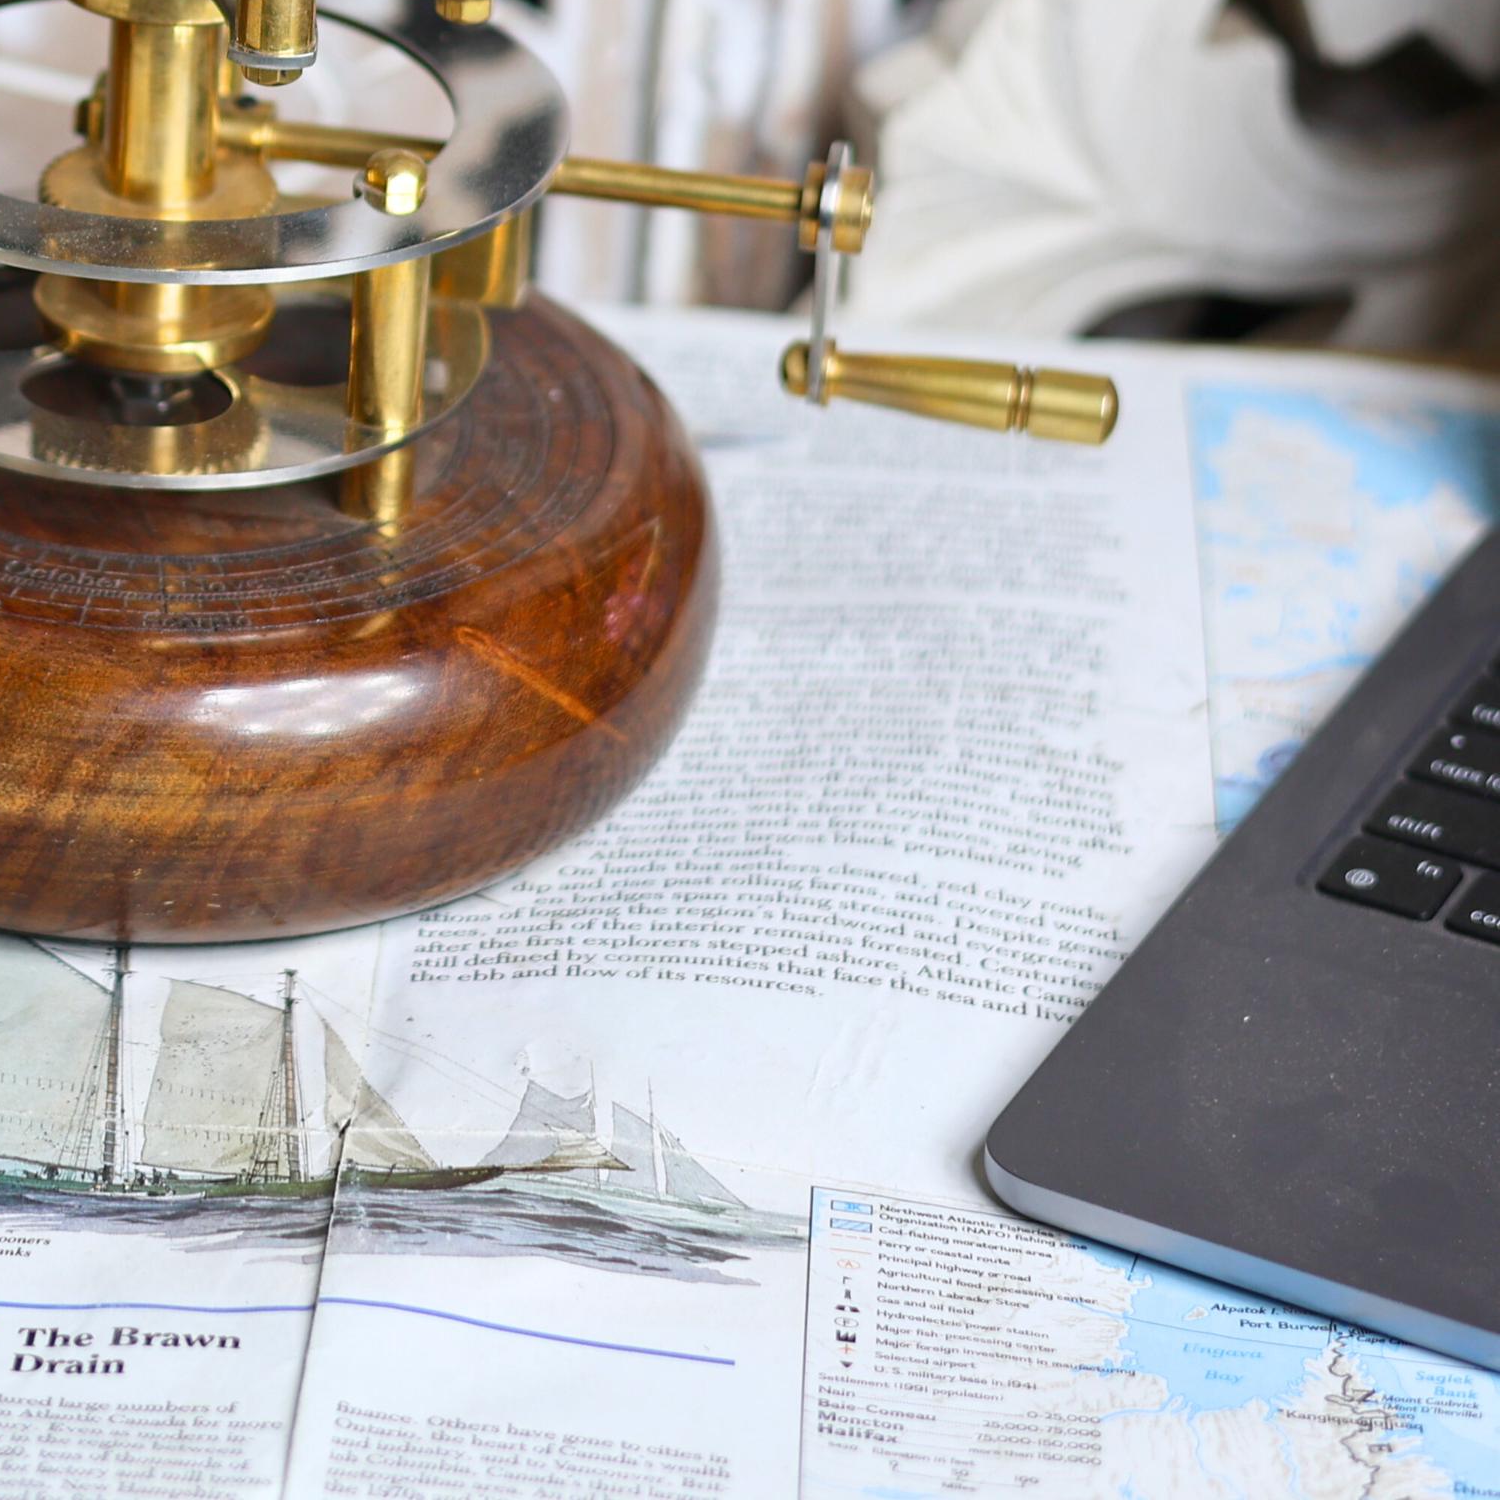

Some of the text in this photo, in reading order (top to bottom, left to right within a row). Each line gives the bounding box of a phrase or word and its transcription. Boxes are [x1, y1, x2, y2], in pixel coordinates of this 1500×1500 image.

[4, 559, 127, 590] October
[1388, 814, 1443, 840] shift
[1416, 860, 1443, 878] fn
[413, 941, 472, 953] after
[479, 937, 519, 951] the
[525, 935, 575, 947] first
[582, 934, 700, 950] explorers
[707, 939, 809, 958] stepped
[917, 964, 1015, 994] Atlantic
[410, 964, 824, 997] the ebb and flow of its resources.
[412, 955, 459, 969] still
[463, 949, 561, 968] defined
[567, 949, 597, 966] by
[604, 954, 770, 971] communities
[777, 960, 826, 978] that
[833, 967, 883, 986] face
[890, 970, 929, 996] the
[937, 990, 976, 1006] sea
[982, 1000, 1028, 1016] and
[879, 1212, 958, 1232] Organization
[1015, 1234, 1055, 1247] fishing
[1060, 1242, 1088, 1250] zone
[880, 1204, 1055, 1238] Northwest Atlantic Fisheries
[878, 1239, 911, 1252] Ferry
[930, 1249, 973, 1260] coastal
[977, 1256, 1010, 1266] route
[879, 1226, 1053, 1258] Cod-fishing moratorium area
[878, 1253, 932, 1267] Principal
[935, 1261, 984, 1278] highway
[1004, 1274, 1031, 1282] road
[877, 1267, 1097, 1305] Agricultural food-processing center
[877, 1281, 1030, 1309] Northern Labrador Store
[877, 1295, 974, 1316] Gas and oil field
[1211, 1303, 1266, 1316] Akpatok
[1239, 1319, 1273, 1329] Port
[17, 1327, 241, 1349] The Brawn
[1183, 1343, 1262, 1359] Ungava
[11, 1353, 125, 1375] Drain
[1205, 1369, 1244, 1385] Bay
[1382, 1394, 1422, 1405] Mount
[1434, 1386, 1478, 1399] Bank
